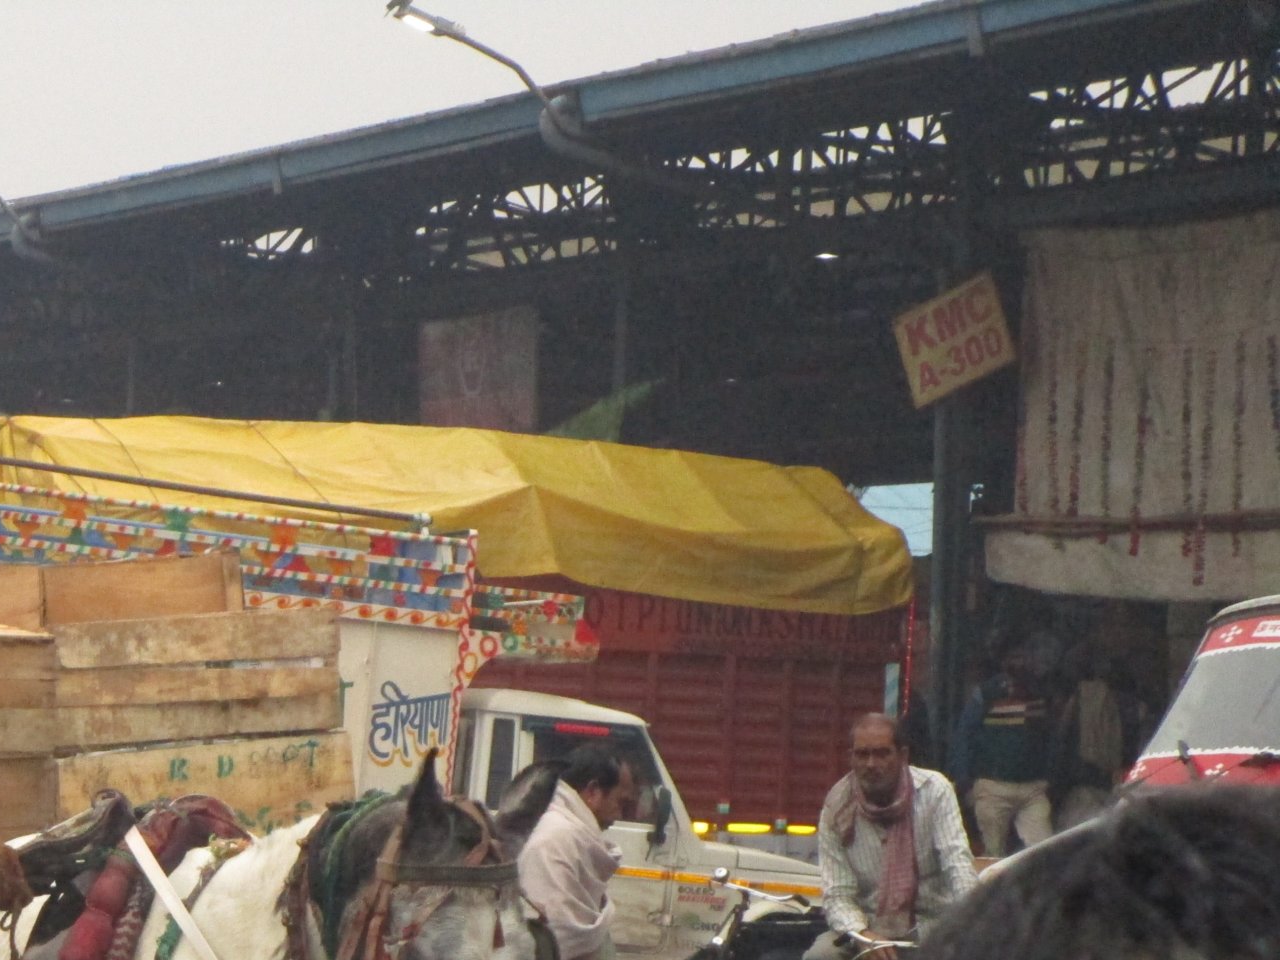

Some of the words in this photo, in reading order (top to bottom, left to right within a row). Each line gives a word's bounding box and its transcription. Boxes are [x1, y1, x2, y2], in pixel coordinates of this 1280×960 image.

[904, 283, 993, 356] KMC
[919, 325, 1002, 390] A-300
[368, 681, 451, 760] हरियाणा
